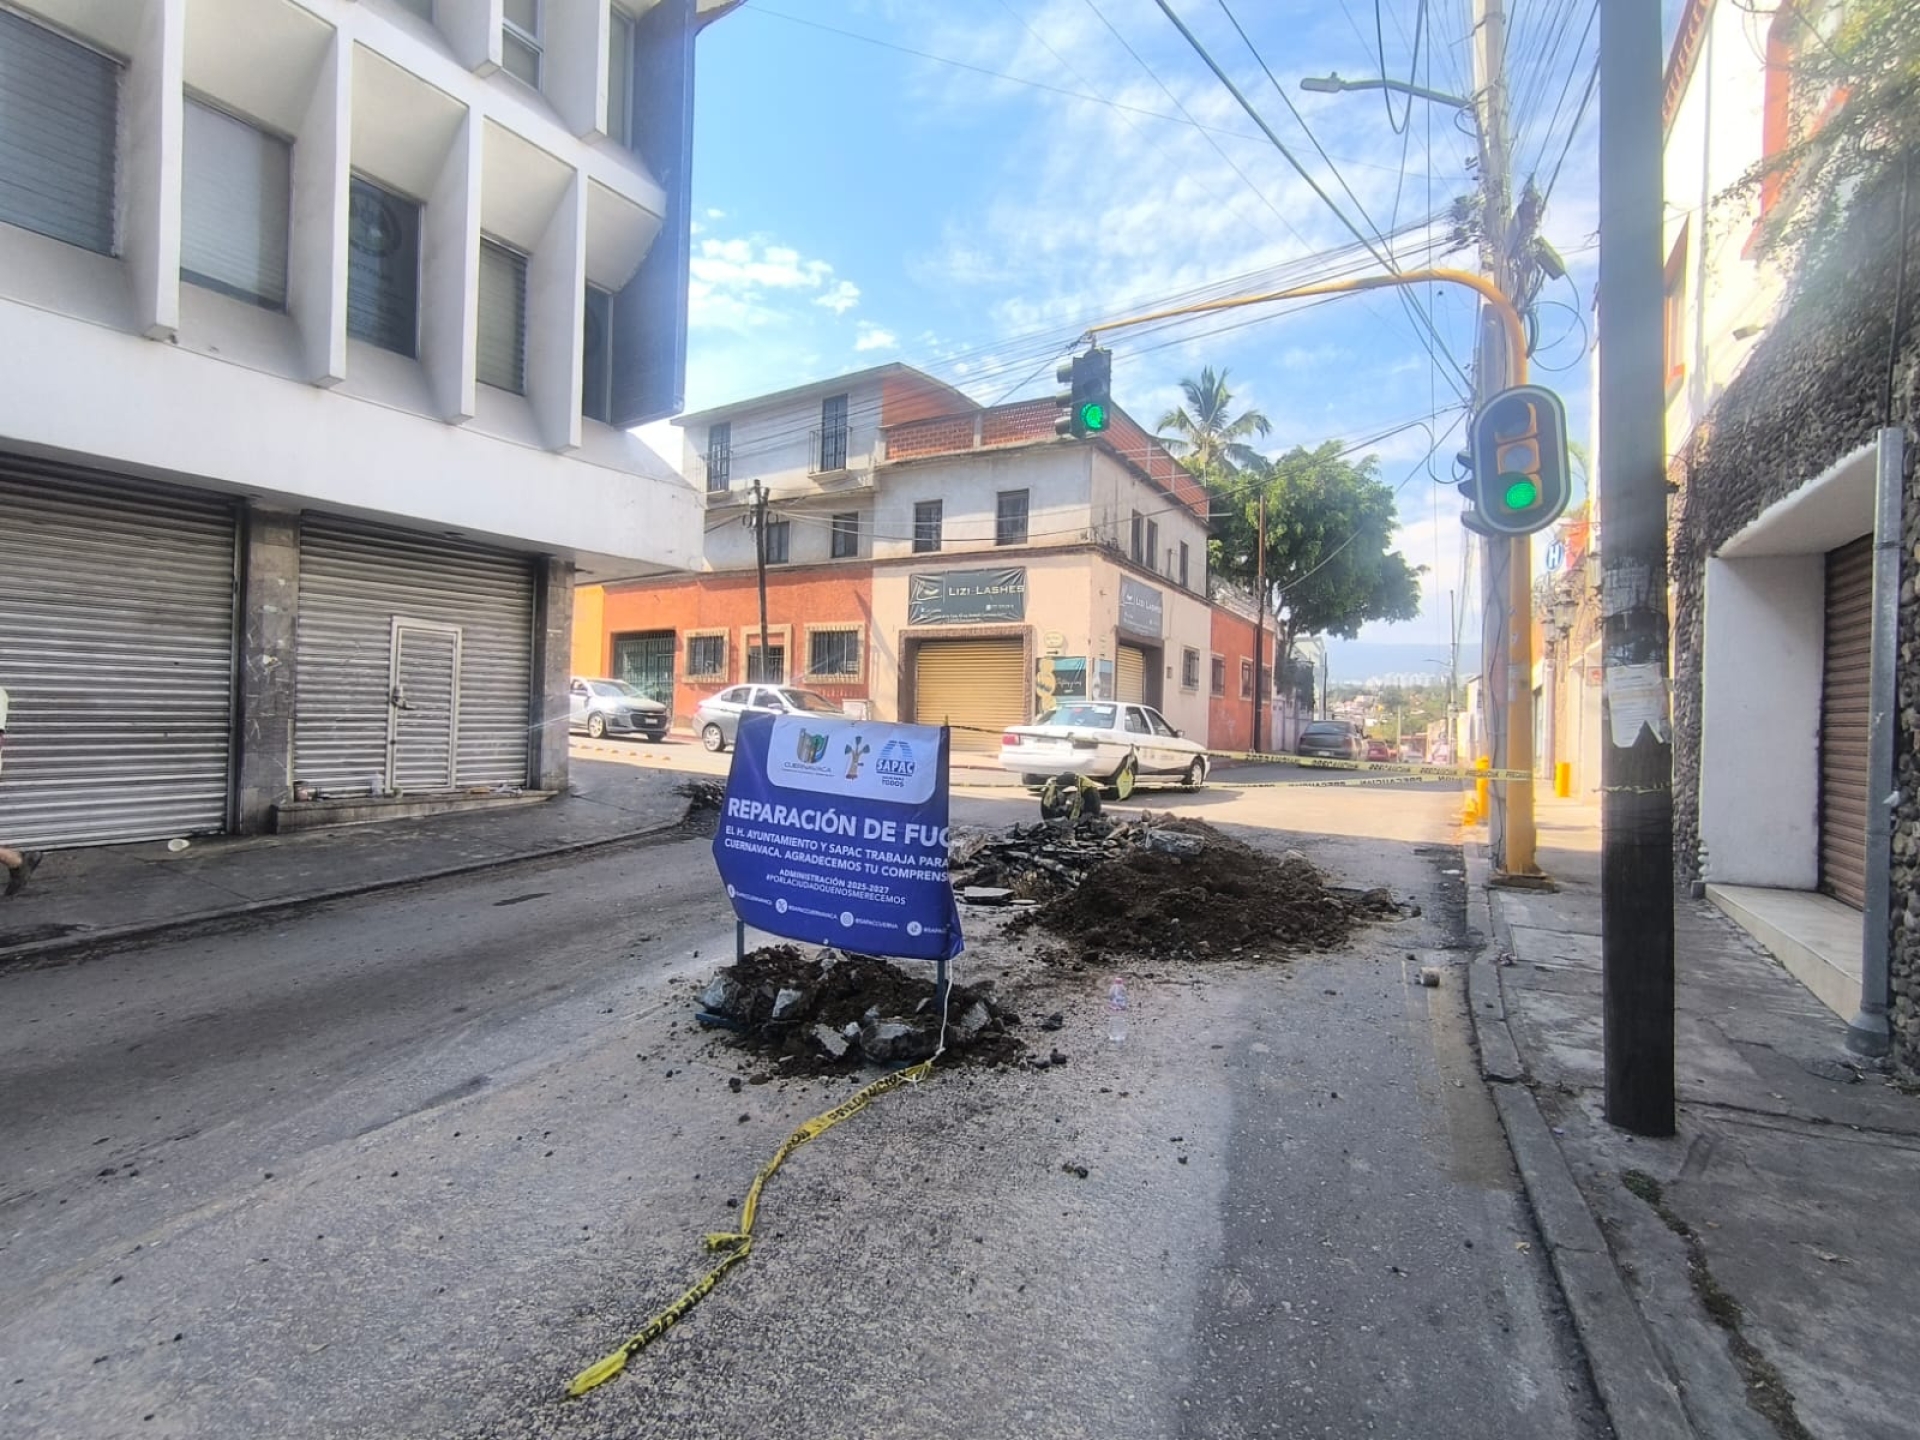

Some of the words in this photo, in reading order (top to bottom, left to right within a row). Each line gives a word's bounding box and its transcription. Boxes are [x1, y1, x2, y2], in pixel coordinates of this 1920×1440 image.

[949, 587, 970, 596] LIZI
[976, 584, 1025, 595] LASHES
[877, 759, 914, 774] SAPAC
[728, 798, 857, 837] REPARACIÓN
[863, 818, 897, 842] DE
[725, 825, 735, 835] EL
[747, 829, 818, 850] AYUNTAMIENTO
[820, 842, 828, 852] Y
[829, 844, 862, 858] SAPAC
[864, 849, 916, 865] TRABAJA
[919, 856, 948, 868] PARA
[725, 838, 782, 858] CUERNAVACA.
[785, 850, 862, 872] AGRADECEMOS
[864, 863, 878, 874] TU
[779, 869, 846, 887] ADMINISTRACIÓN
[847, 881, 890, 894] 2025-2027
